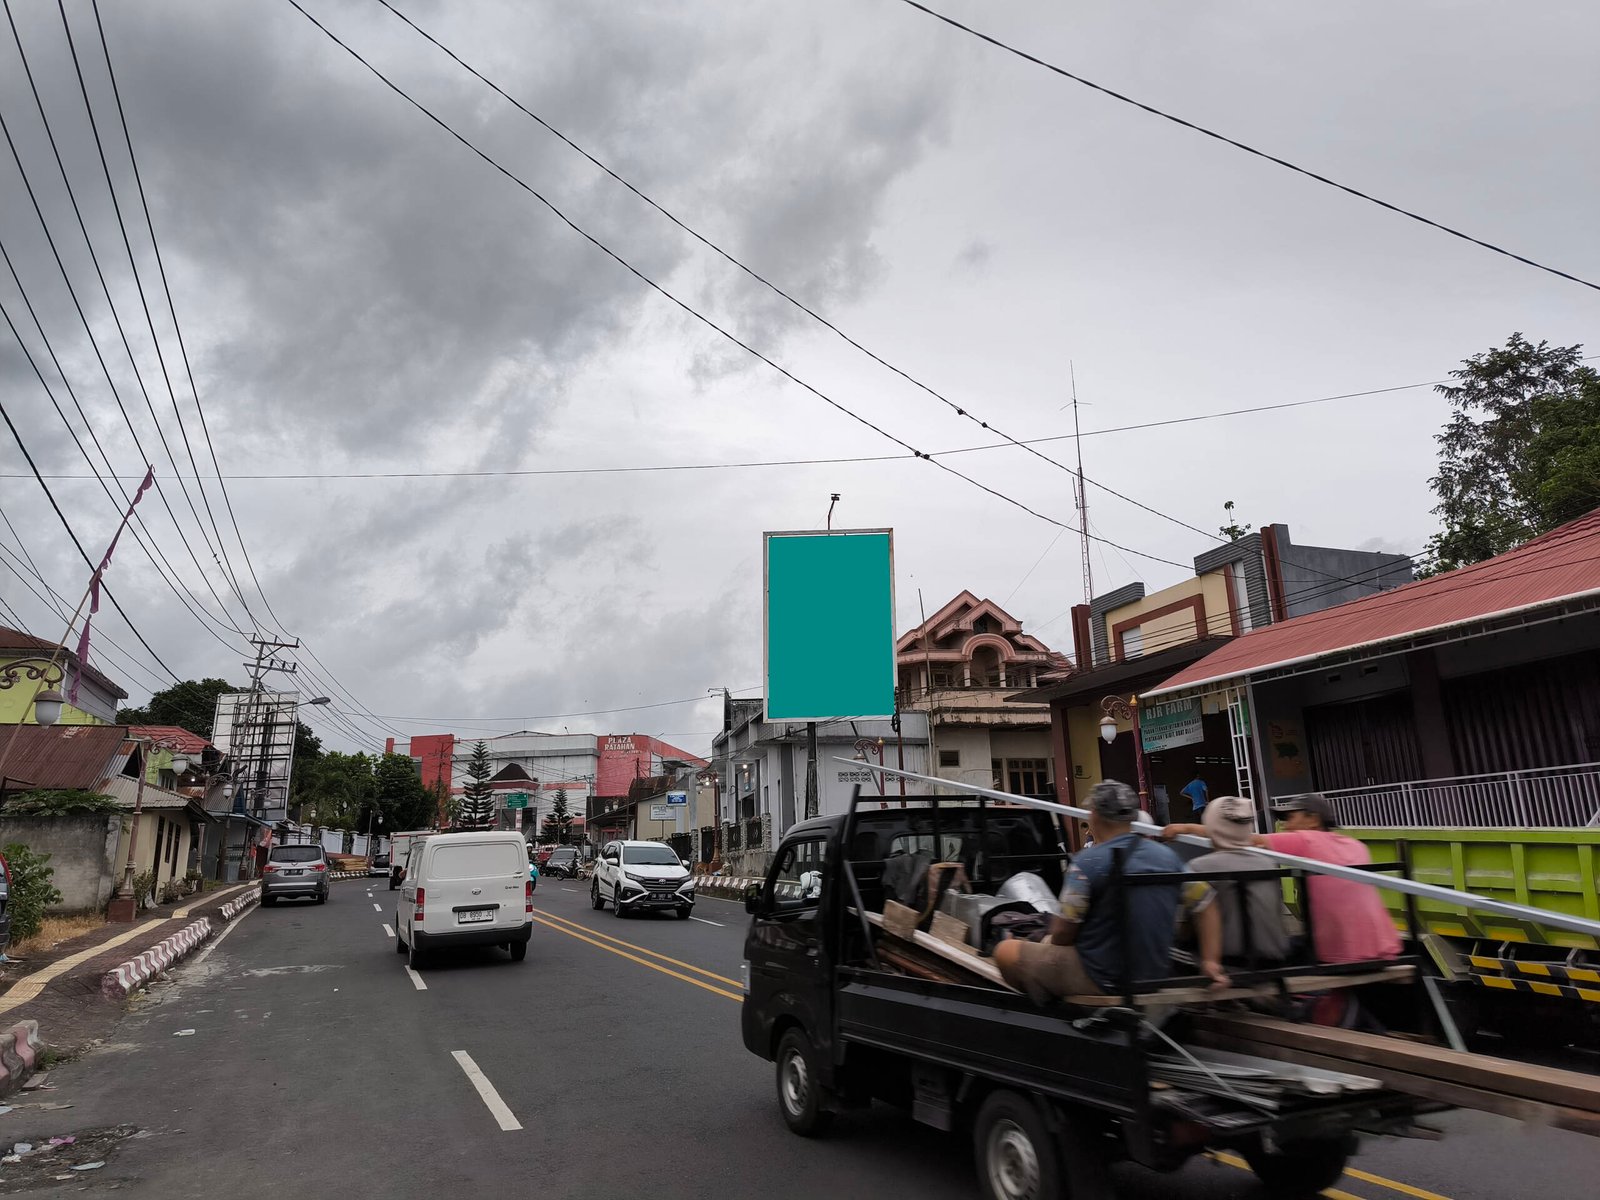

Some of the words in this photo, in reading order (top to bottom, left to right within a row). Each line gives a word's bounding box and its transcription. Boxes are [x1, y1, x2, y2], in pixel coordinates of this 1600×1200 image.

[1146, 706, 1163, 720] RJR
[1165, 699, 1192, 714] FARM
[604, 743, 635, 751] RATAHAN
